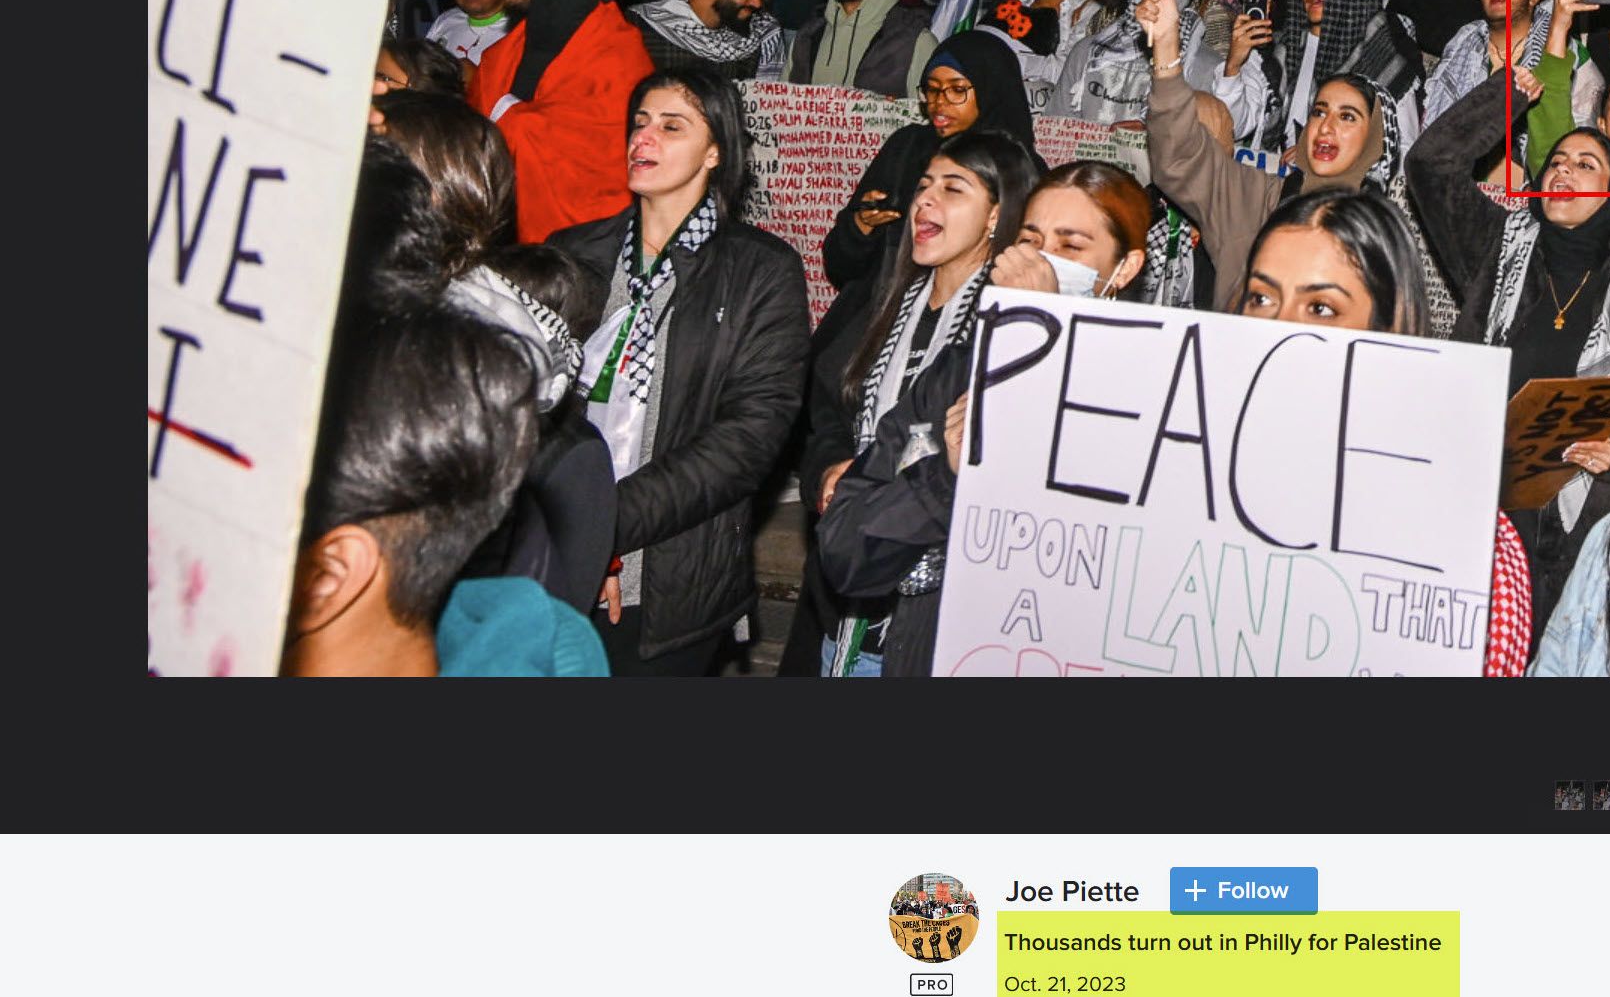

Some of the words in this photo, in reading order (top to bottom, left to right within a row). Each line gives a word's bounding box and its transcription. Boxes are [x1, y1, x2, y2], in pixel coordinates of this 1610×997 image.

[968, 301, 1446, 574] PEACE
[962, 503, 1109, 590] UPON
[1102, 525, 1361, 677] LAND
[1360, 572, 1493, 651] THAT
[1000, 588, 1044, 643] A
[1005, 880, 1053, 903] Joe
[1062, 880, 1140, 903] Piette
[1218, 881, 1290, 900] Follow
[1003, 933, 1122, 951] Thousands
[1127, 934, 1171, 951] turn
[1177, 934, 1213, 951] out
[1219, 933, 1238, 951] in
[1245, 933, 1303, 956] Philly
[1308, 933, 1339, 951] for
[1344, 933, 1442, 951] Palestine
[917, 979, 948, 991] PRO
[1004, 976, 1042, 992] Oct.
[1047, 976, 1071, 995] 21,
[1077, 976, 1126, 992] 2023
